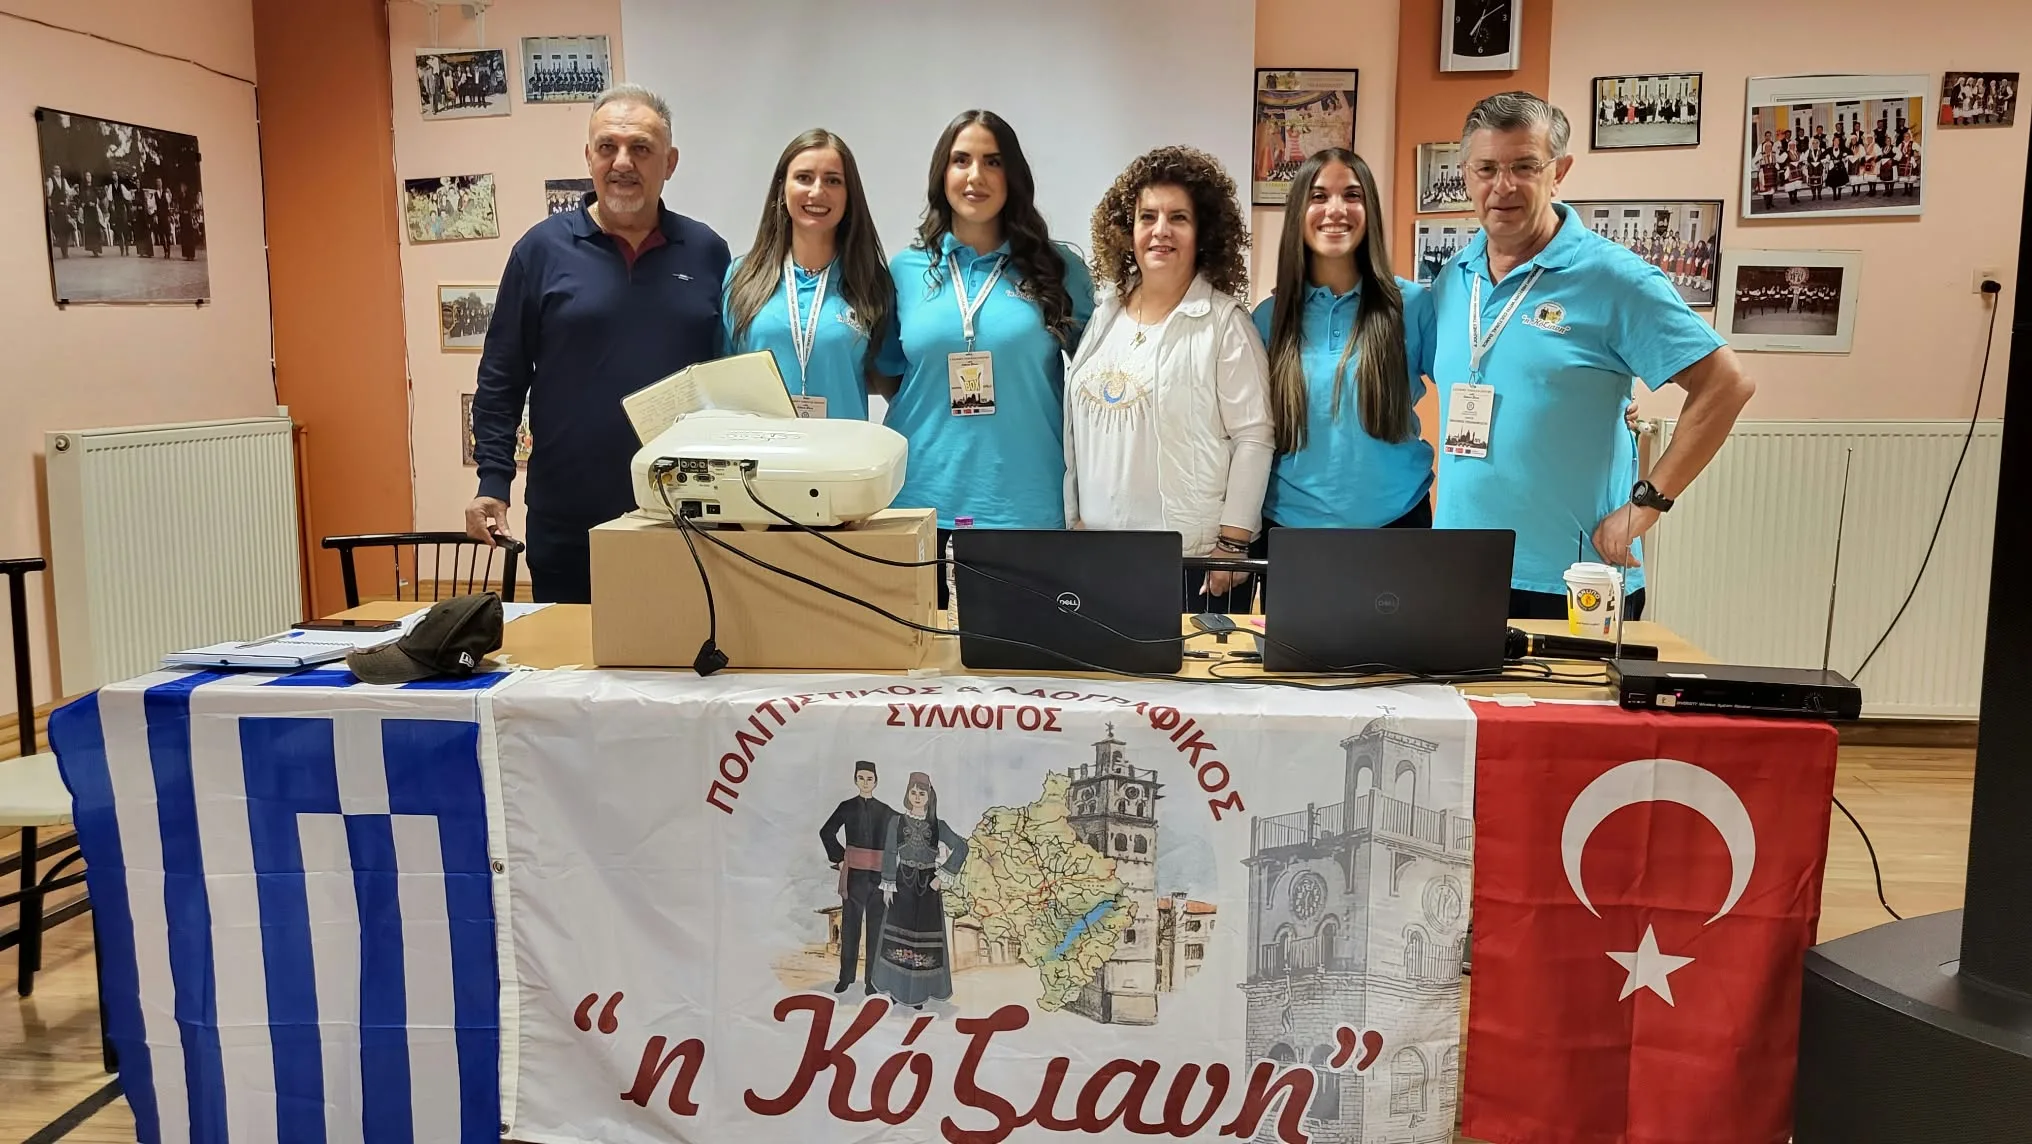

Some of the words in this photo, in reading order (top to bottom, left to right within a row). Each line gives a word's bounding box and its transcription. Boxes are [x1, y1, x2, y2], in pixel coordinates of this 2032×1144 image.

[1478, 46, 1483, 54] 6
[1481, 332, 1494, 348] DANCE
[886, 703, 1063, 732] ΣΥΛΛΟΓΟΣ
[706, 685, 943, 815] ΠΟΛΙΤΙΣΤΙΚΟΣ
[995, 687, 1246, 822] ΛΑΟΓΡΑΦΙΚΟΣ
